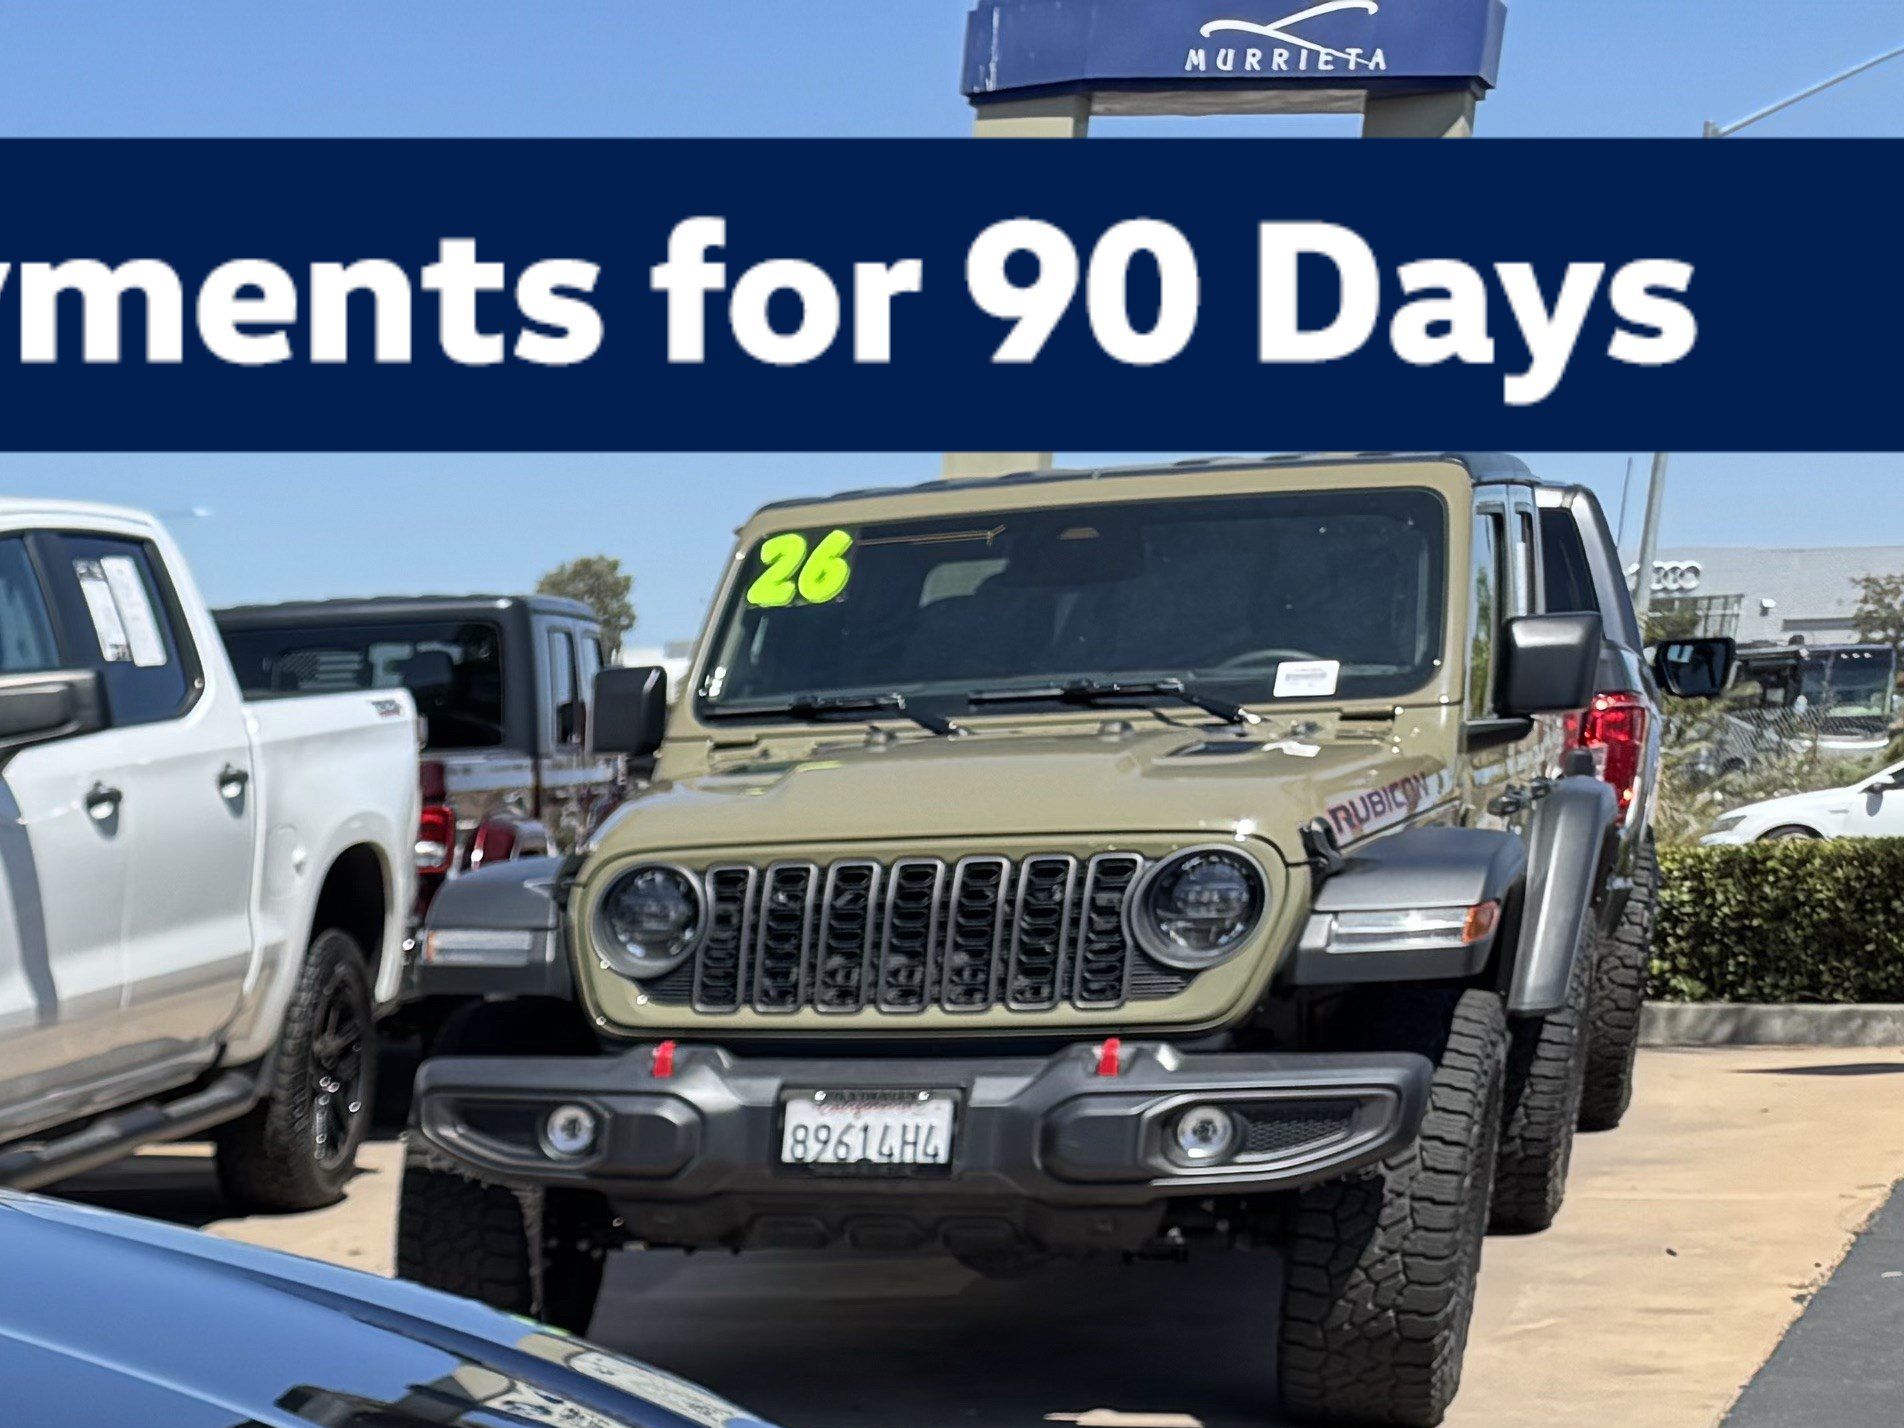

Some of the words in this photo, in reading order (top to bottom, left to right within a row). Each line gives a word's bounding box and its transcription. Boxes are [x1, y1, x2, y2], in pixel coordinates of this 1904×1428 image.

[1184, 47, 1388, 72] MURRIETA
[746, 528, 853, 607] 26
[791, 1123, 939, 1163] 89614H4
